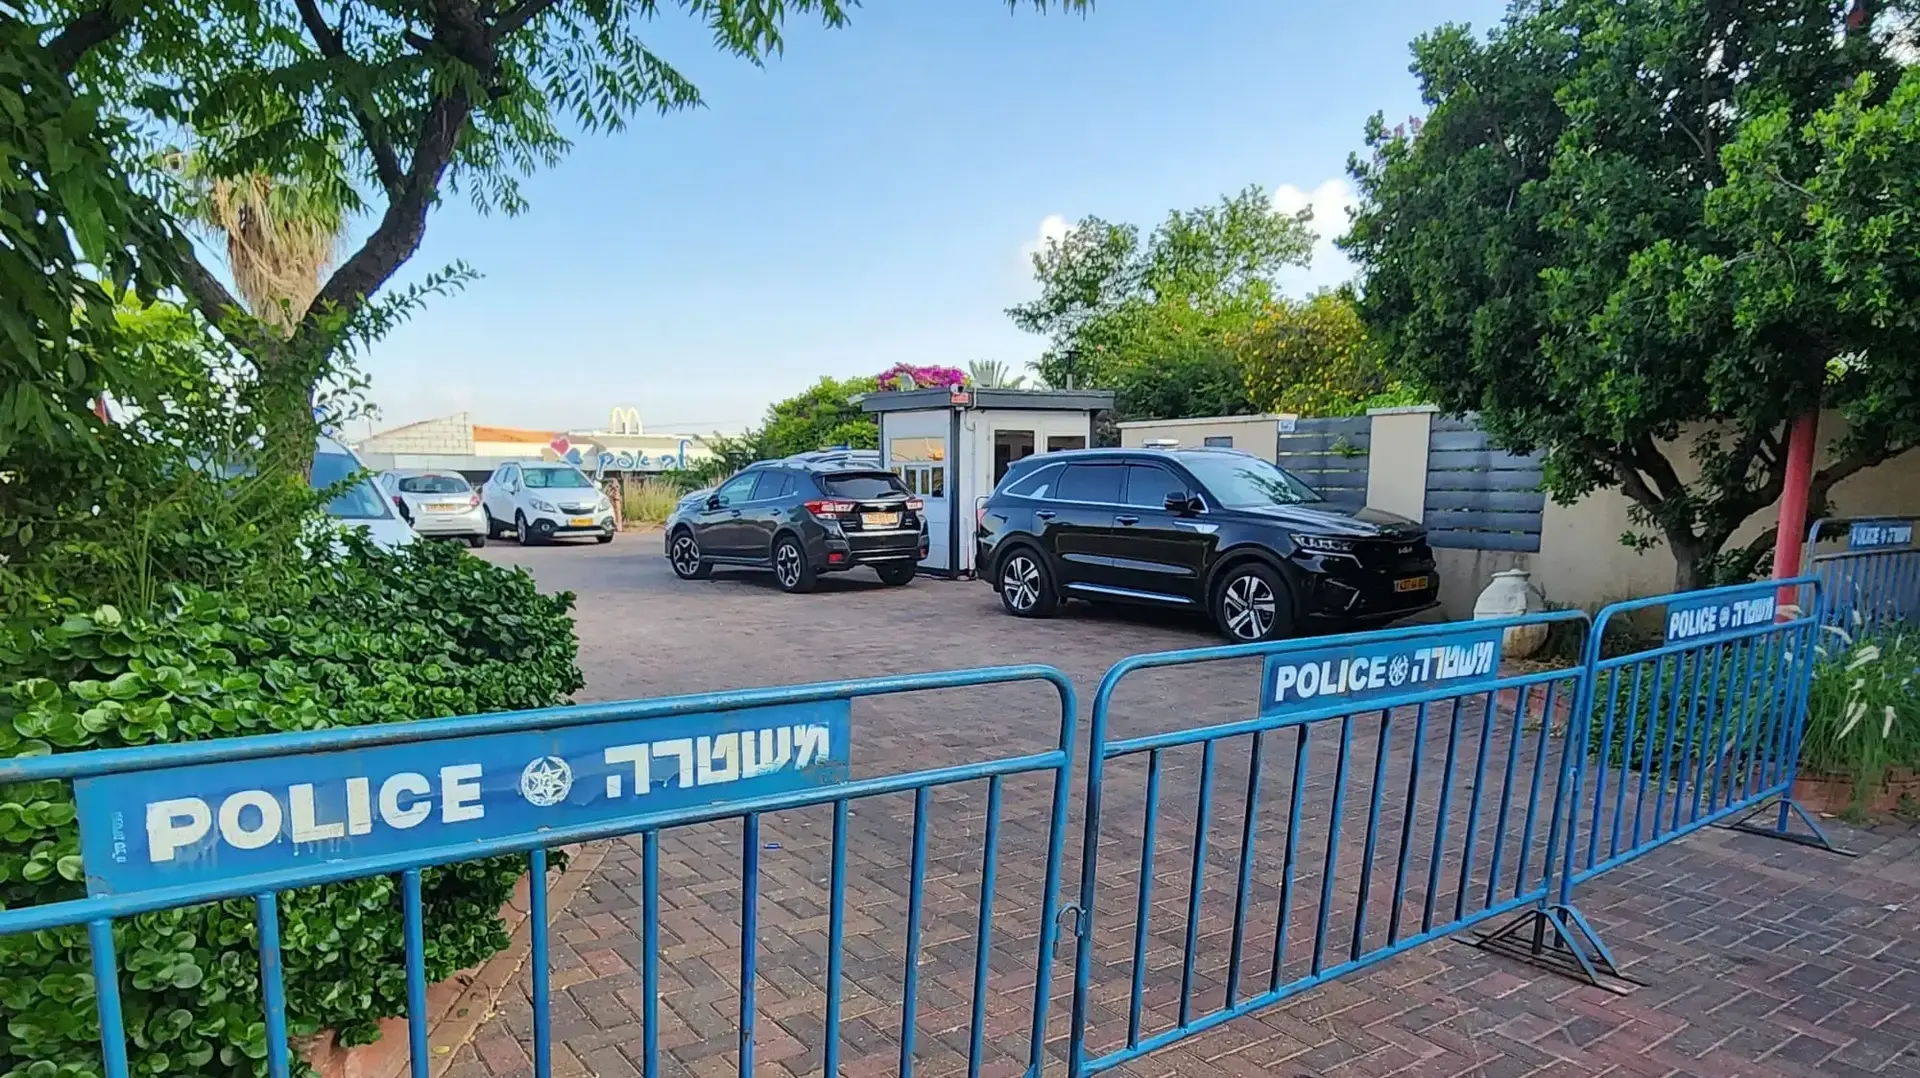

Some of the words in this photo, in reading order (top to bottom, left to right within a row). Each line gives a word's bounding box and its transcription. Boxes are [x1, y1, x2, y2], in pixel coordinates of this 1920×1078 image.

[1668, 606, 1717, 640] POLICE
[1731, 596, 1775, 628] משטרה
[1275, 656, 1388, 701] POLICE
[1411, 641, 1495, 683] משטרה
[604, 722, 830, 799] משטרה
[146, 763, 485, 863] POLICE
